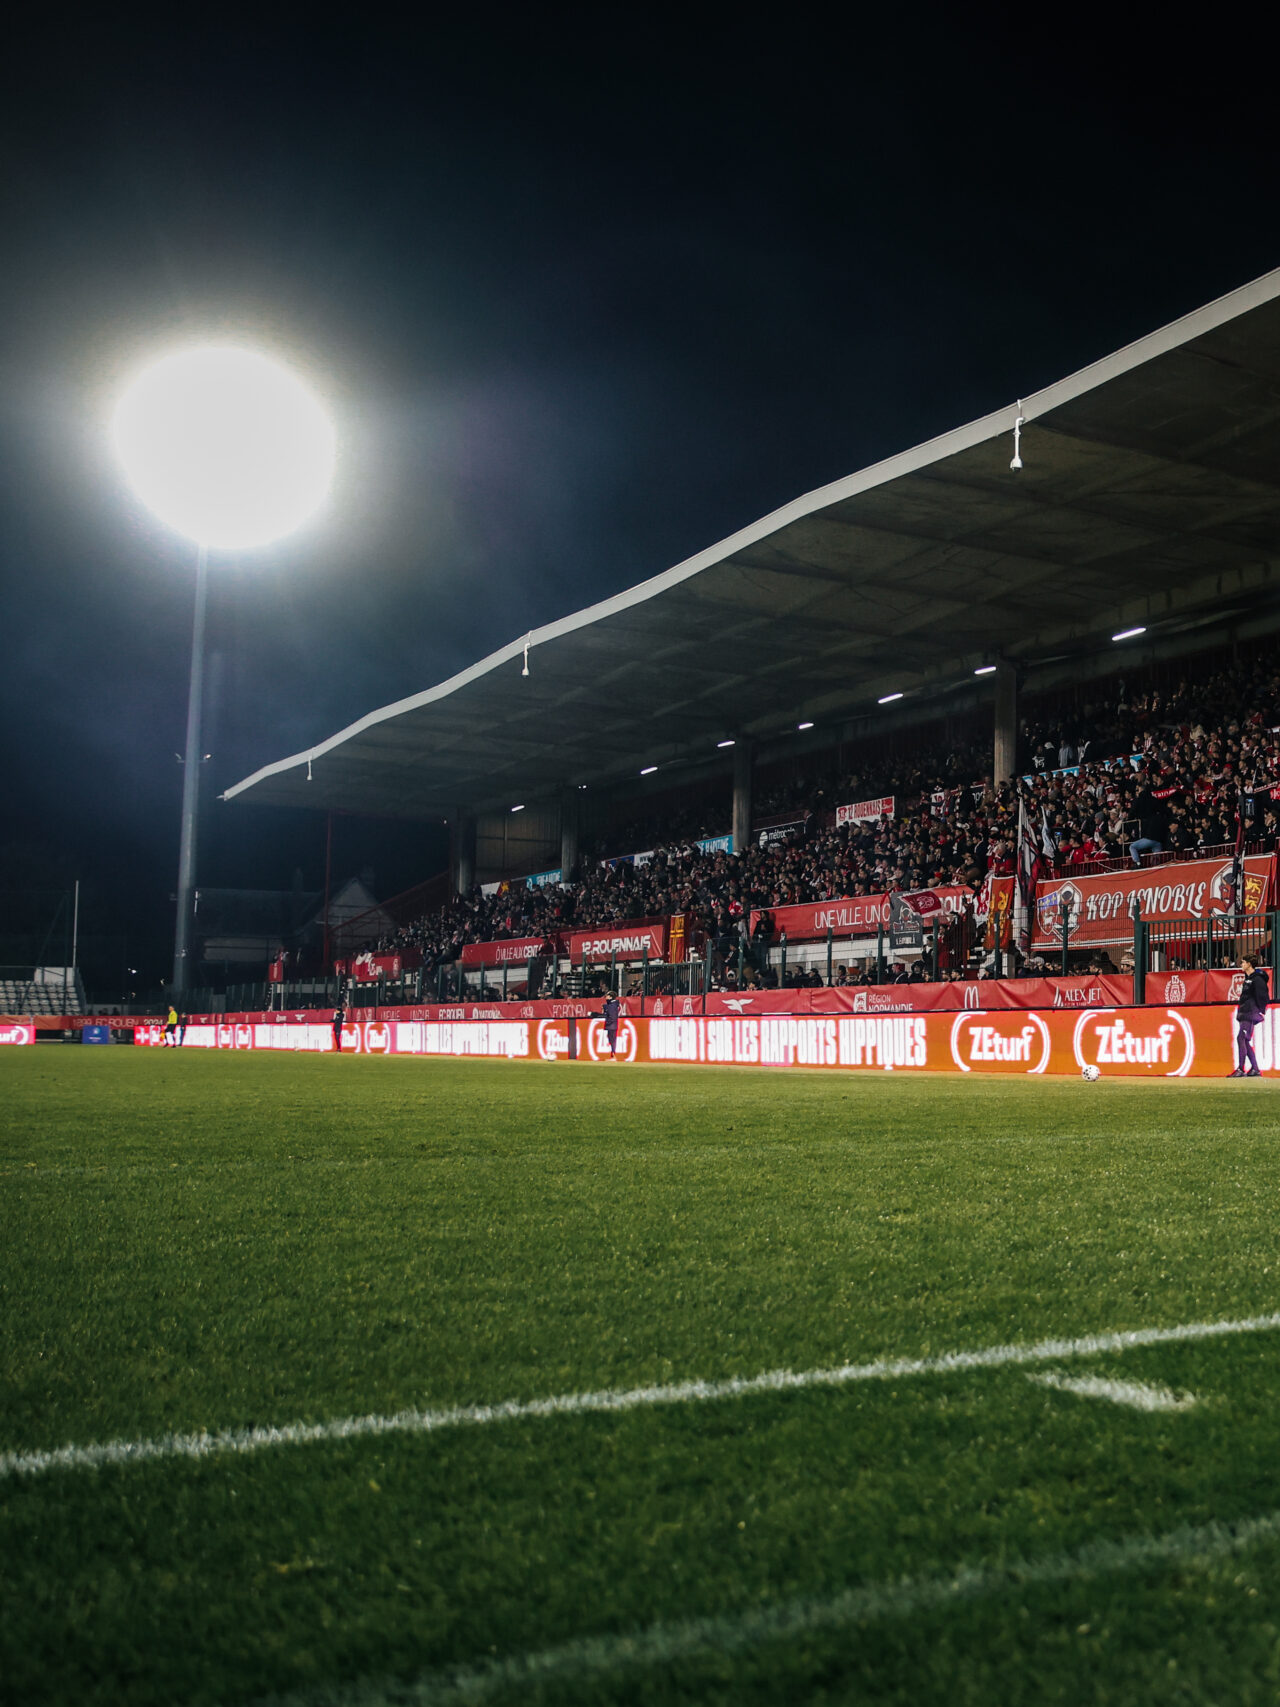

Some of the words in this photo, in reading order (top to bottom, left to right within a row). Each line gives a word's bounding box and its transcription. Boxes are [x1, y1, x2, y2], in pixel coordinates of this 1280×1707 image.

[1064, 988, 1086, 1002] ALEX
[1087, 988, 1102, 1004] JET
[708, 1019, 733, 1062] SUR
[735, 1019, 758, 1063] LES
[760, 1018, 836, 1064] RAPPORTS
[838, 1018, 926, 1070] HIPPIQUES
[970, 1026, 1035, 1061] ZEturf
[1096, 1023, 1174, 1063] ZEturf
